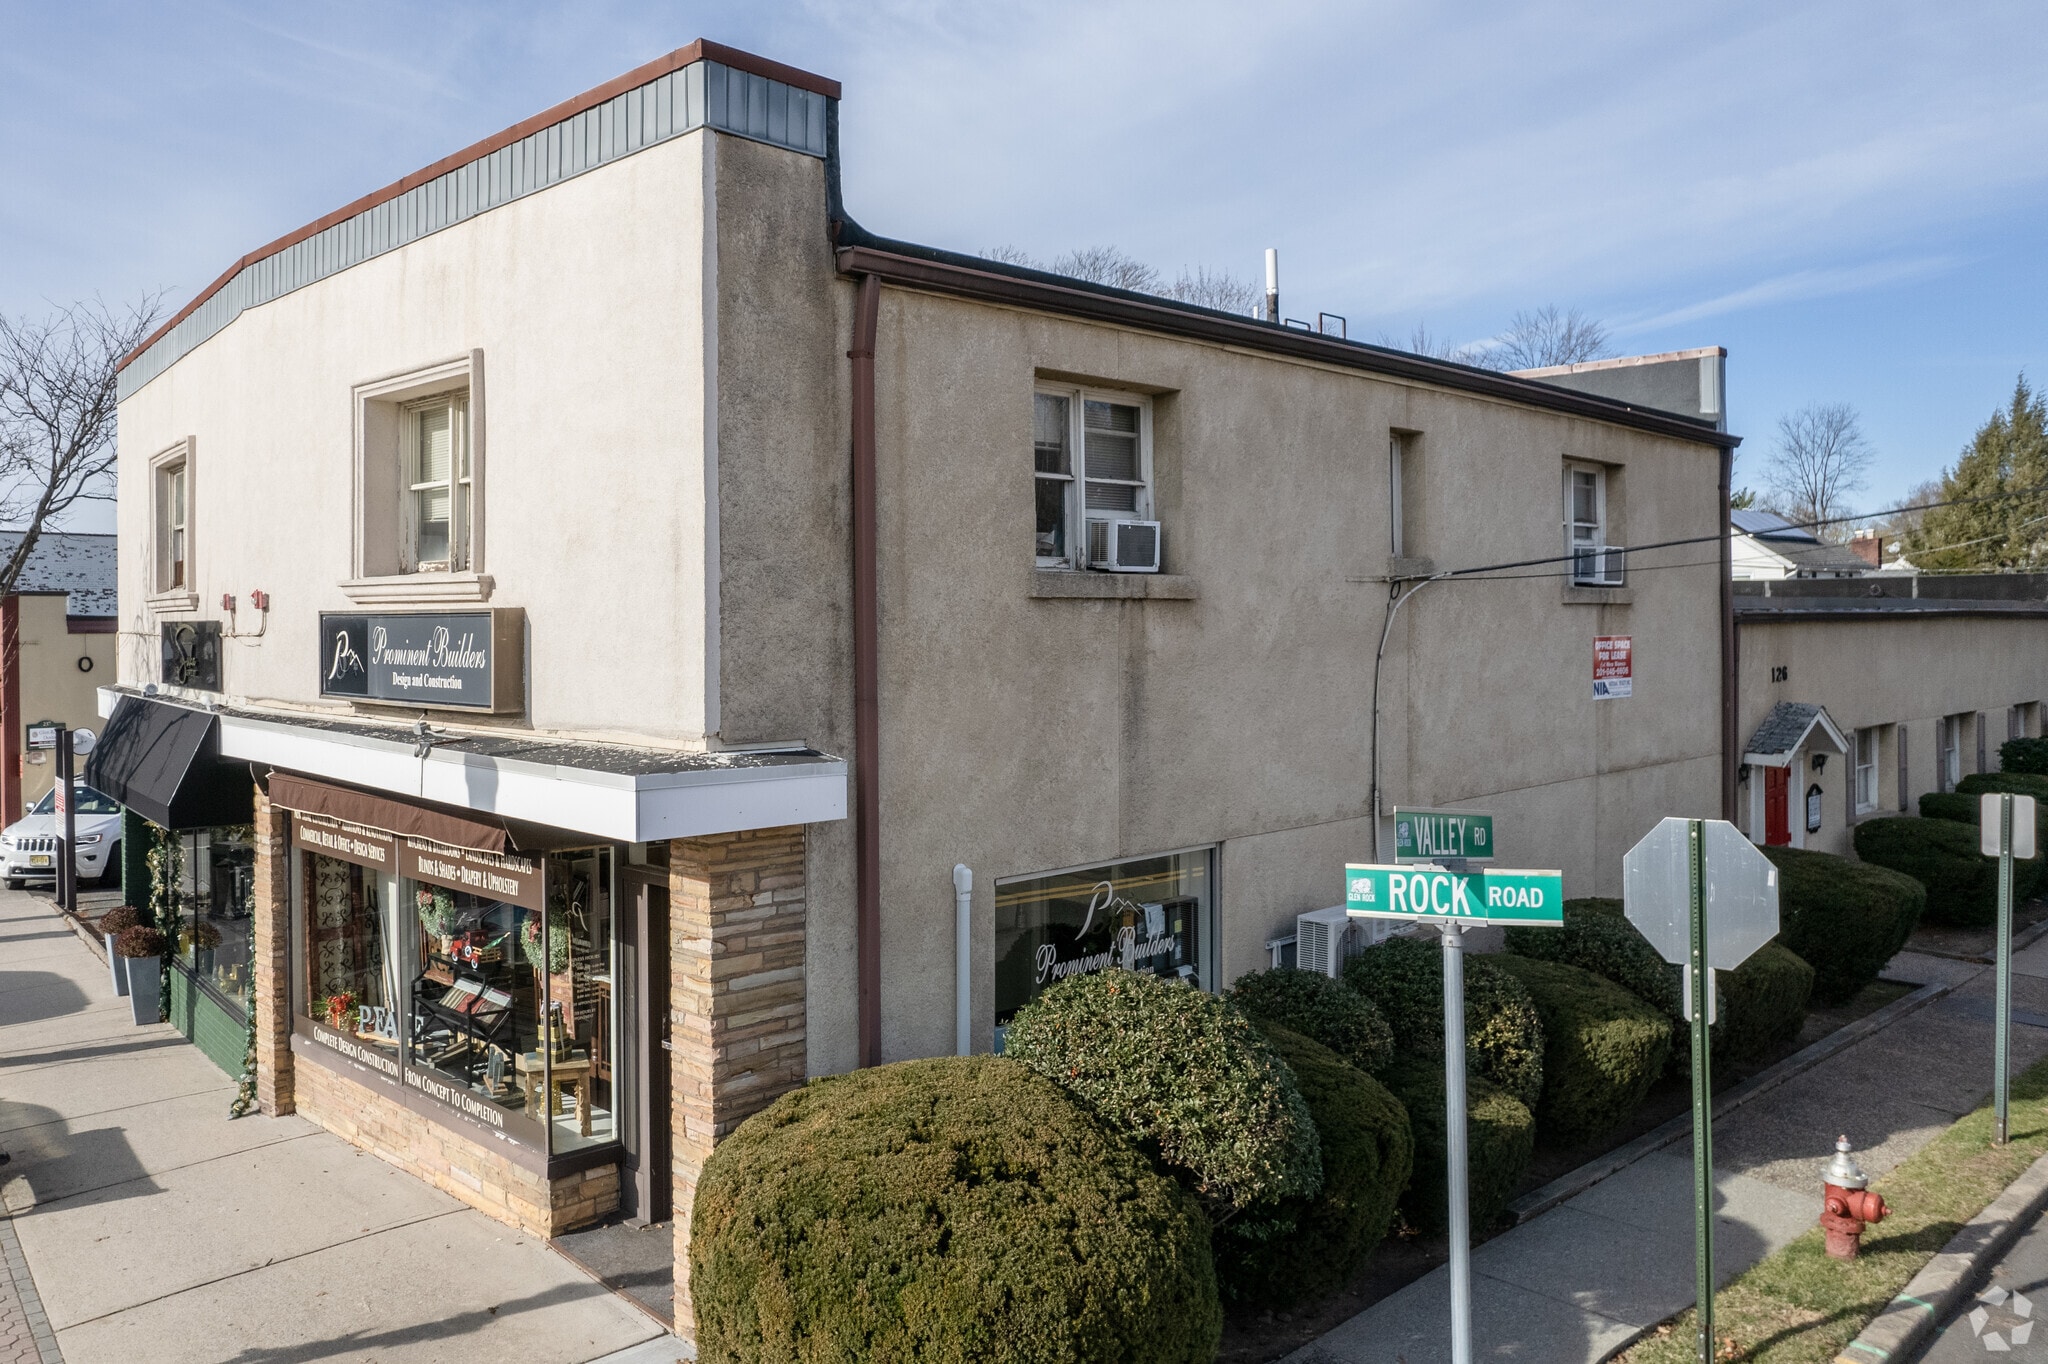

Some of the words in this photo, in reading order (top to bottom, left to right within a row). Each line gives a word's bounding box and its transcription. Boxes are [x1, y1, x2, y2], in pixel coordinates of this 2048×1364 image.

[373, 626, 433, 666] Prominent
[433, 626, 487, 669] Builders
[392, 672, 411, 689] Design
[412, 674, 423, 687] and
[424, 674, 462, 689] Construction
[1771, 666, 1788, 683] 126
[1414, 816, 1466, 855] VALLEY
[1474, 827, 1486, 846] RD
[418, 856, 434, 875] BLINDS
[434, 860, 438, 876] &
[439, 860, 456, 880] SHADES
[461, 866, 482, 886] DRAPERY
[483, 871, 487, 888] &
[488, 872, 519, 896] UPHOLSTERY
[1362, 893, 1376, 902] ROCK
[1389, 874, 1471, 915] ROCK
[1489, 887, 1543, 908] ROAD
[1035, 941, 1116, 984] Prominent
[1117, 926, 1176, 964] Builders
[359, 1005, 425, 1040] PEAE
[313, 1026, 338, 1049] COMPLETE
[338, 1037, 357, 1058] DESIGN
[357, 1046, 399, 1077] CONSTRUCTION
[404, 1066, 421, 1088] FROM
[422, 1076, 450, 1102] CONCEPT
[450, 1088, 460, 1107] TO
[461, 1094, 503, 1128] COMPLETION
